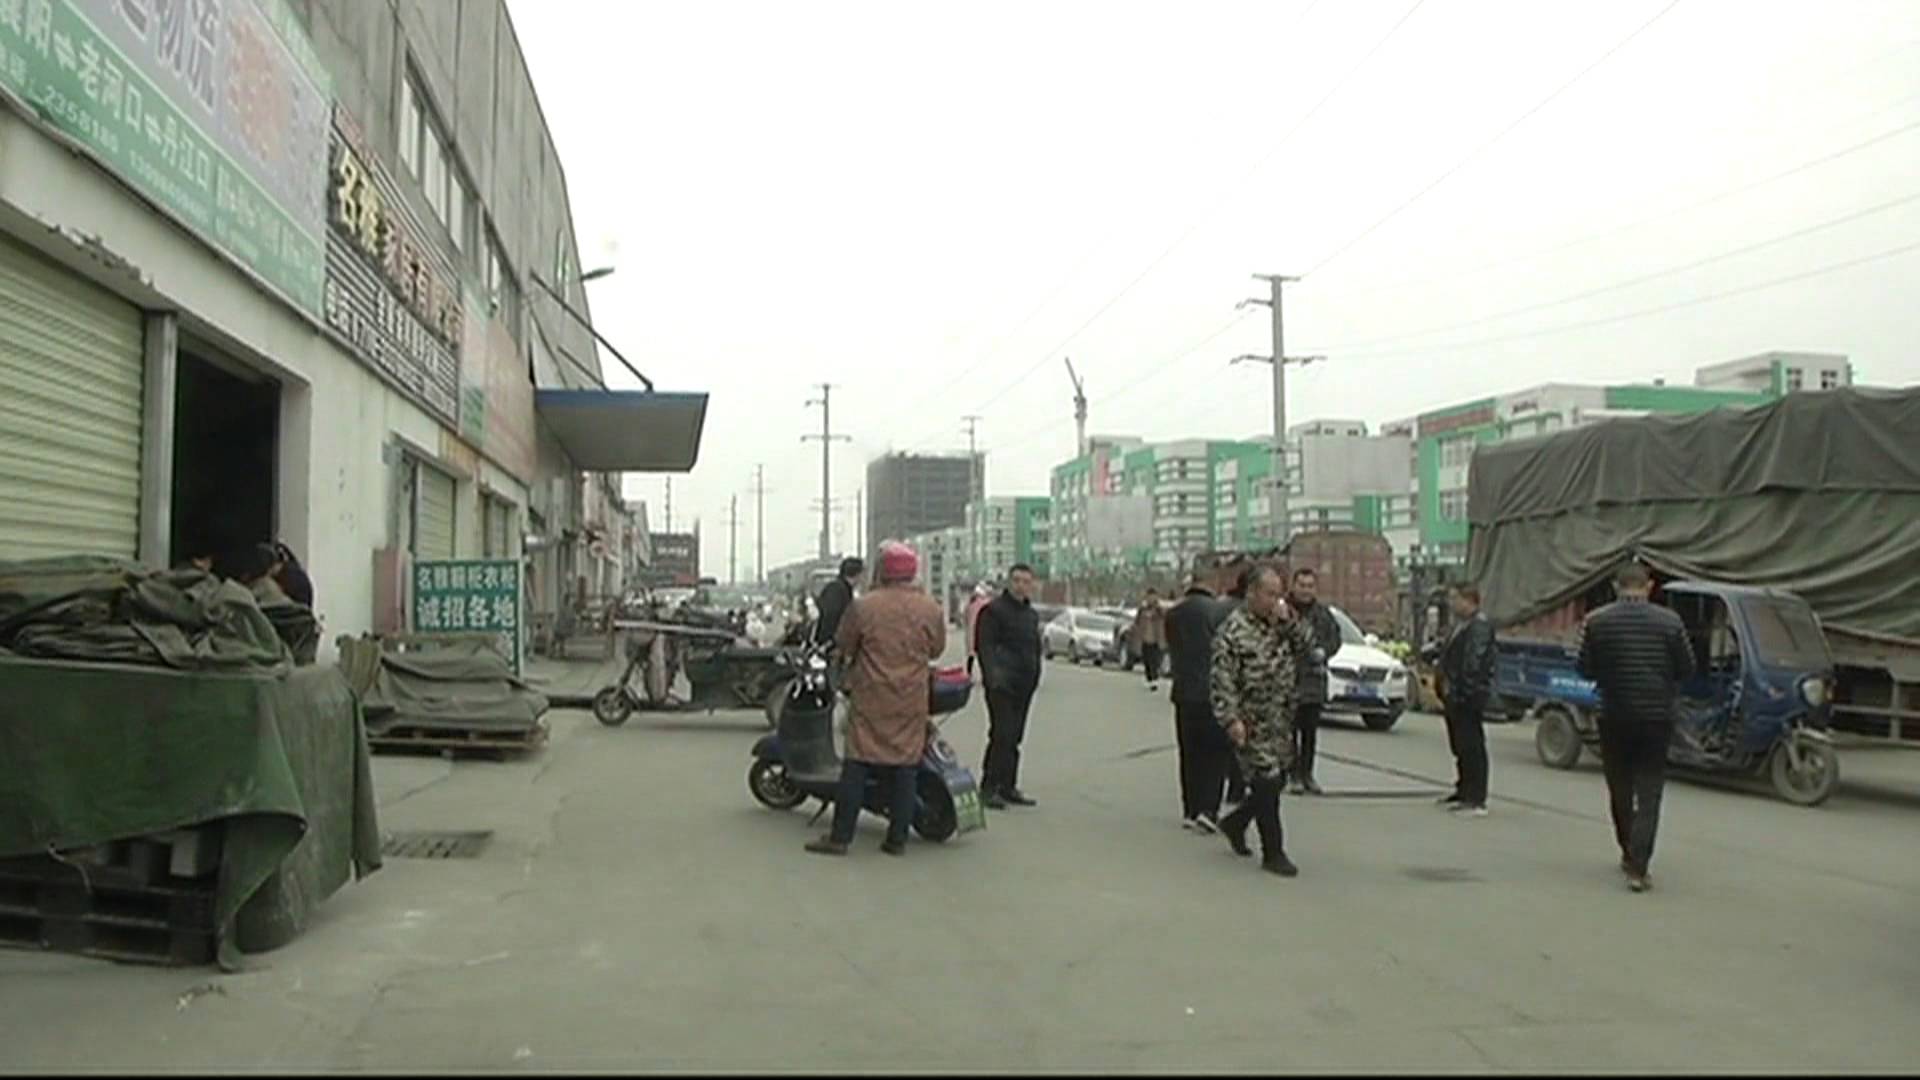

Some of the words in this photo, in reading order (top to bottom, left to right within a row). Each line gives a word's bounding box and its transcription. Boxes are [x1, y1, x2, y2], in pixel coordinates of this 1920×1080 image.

[77, 39, 142, 133] 老河口
[160, 113, 209, 191] 丹江口
